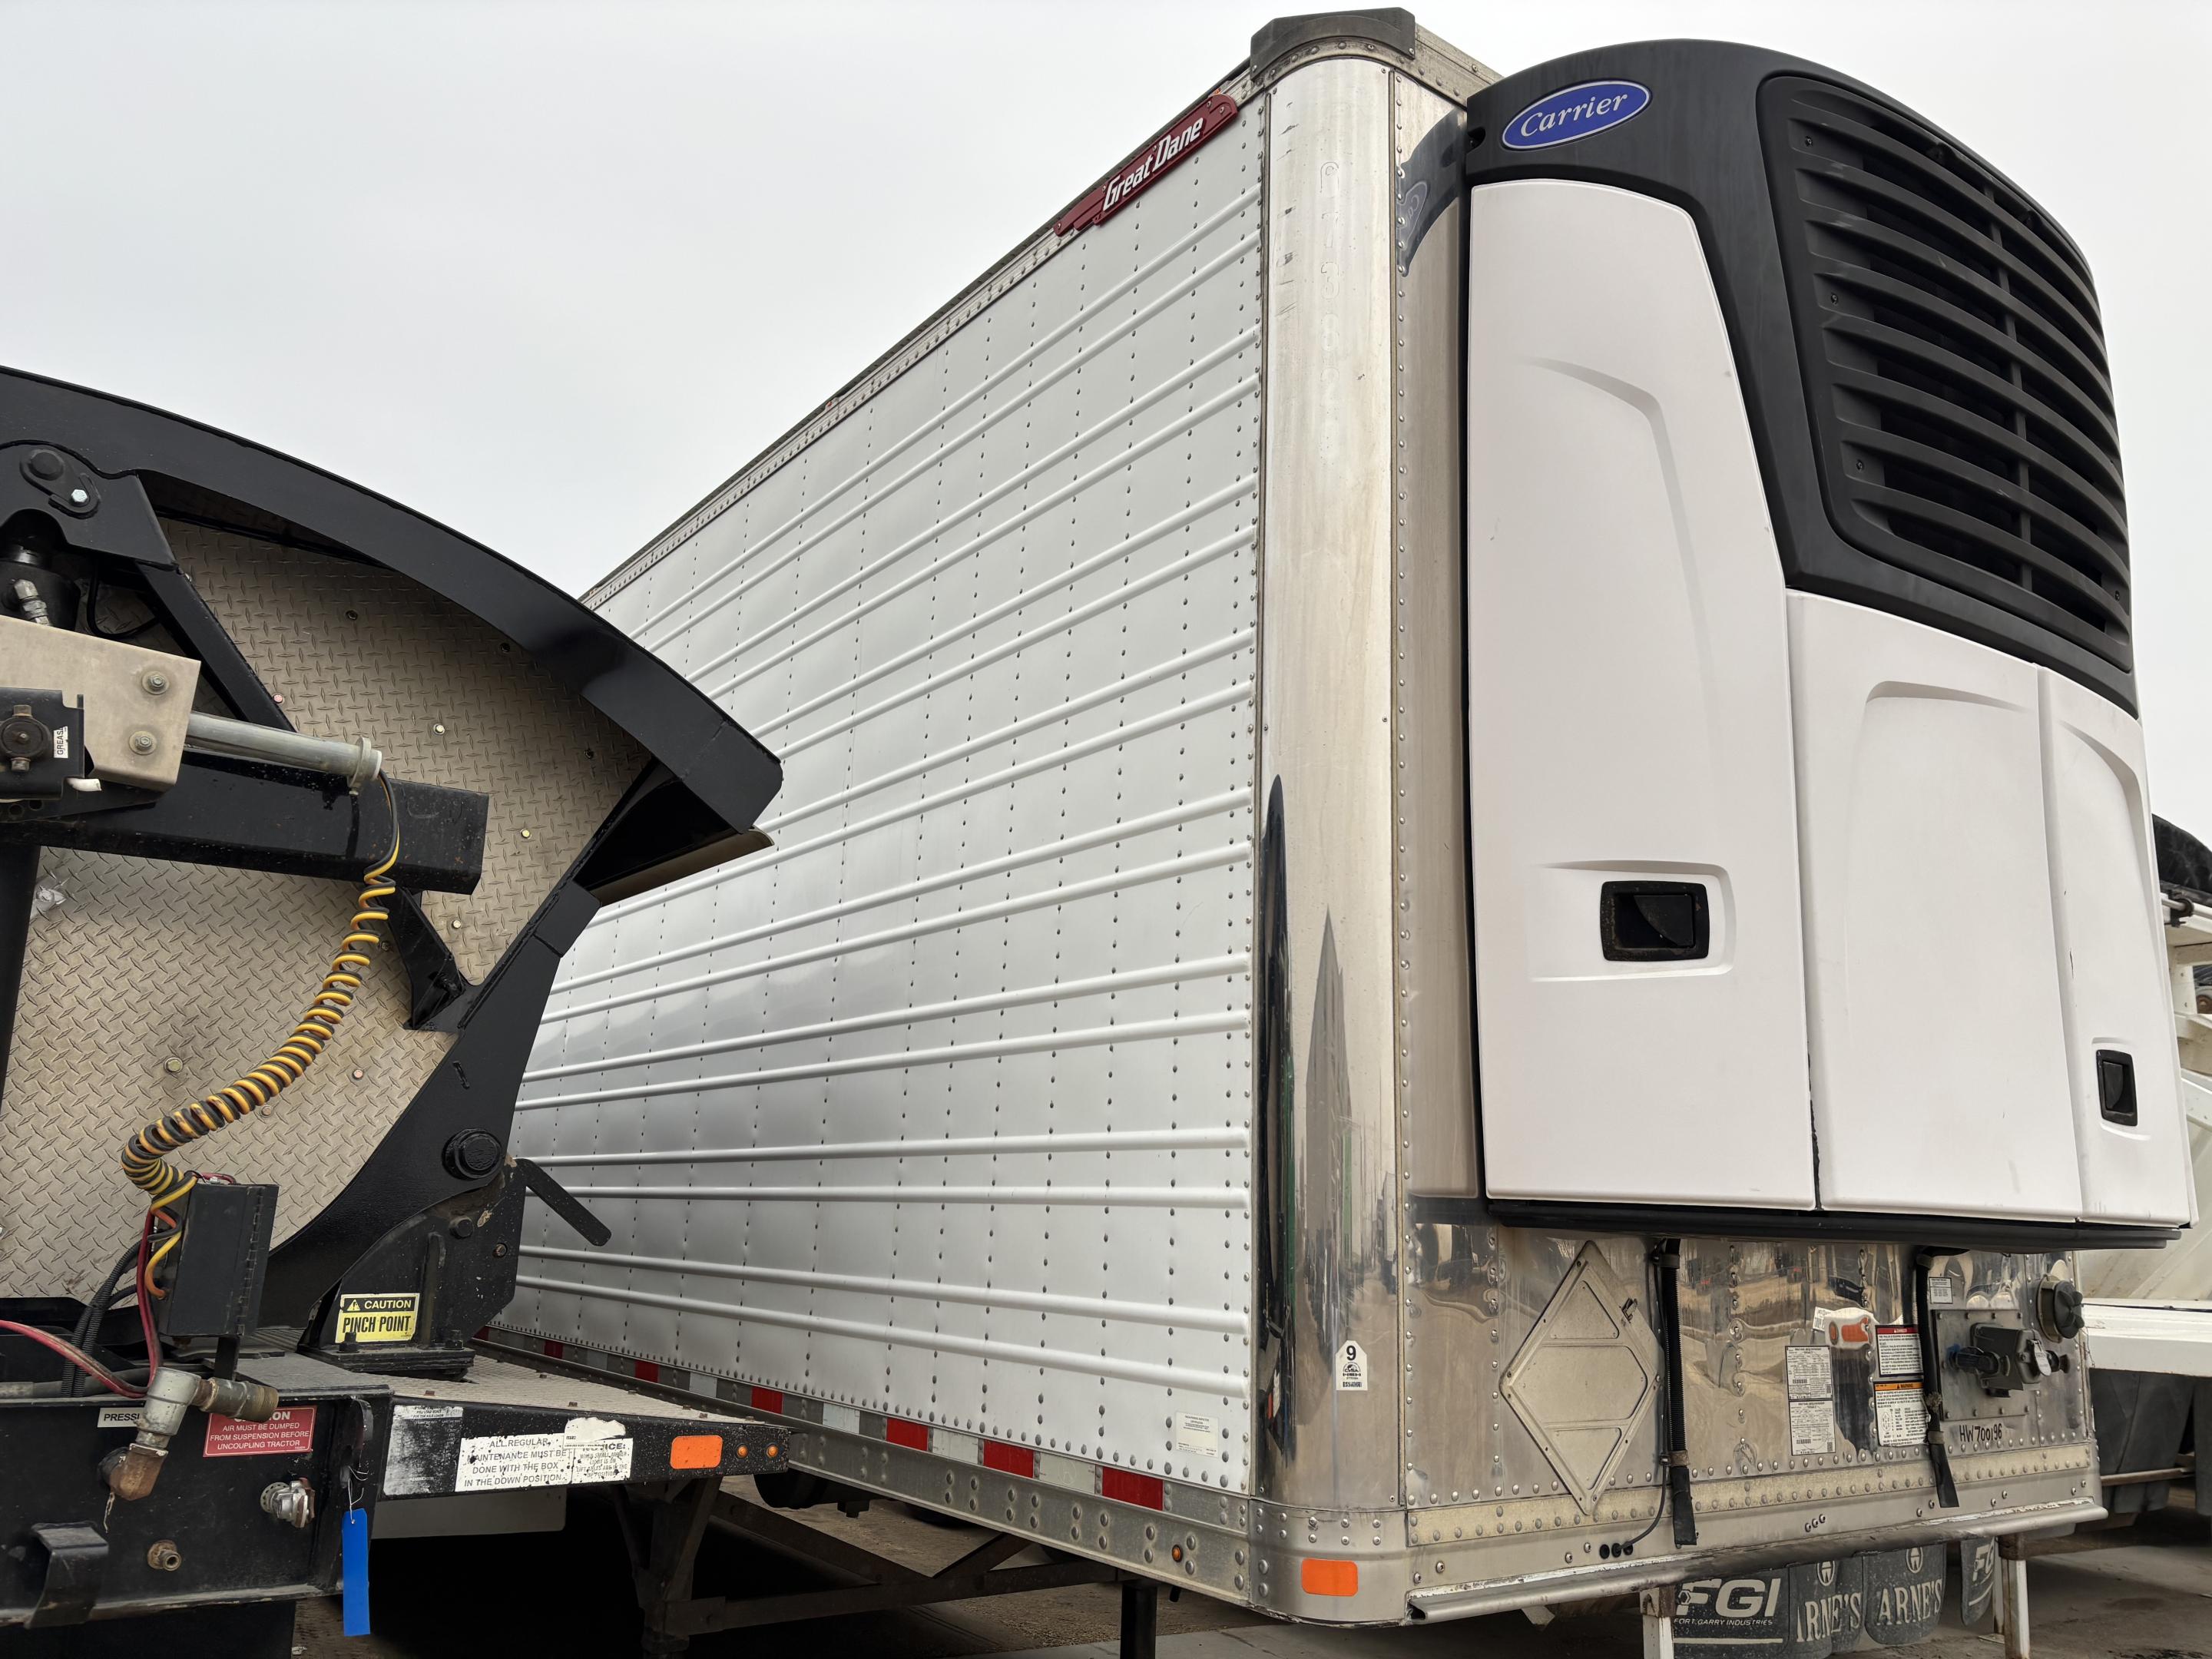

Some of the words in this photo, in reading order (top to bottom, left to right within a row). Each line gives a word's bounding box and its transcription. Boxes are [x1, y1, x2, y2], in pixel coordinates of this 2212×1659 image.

[1521, 94, 1628, 137] Carrier
[1103, 154, 1153, 211] Great
[1152, 118, 1204, 173] Dane
[364, 1300, 412, 1310] CAUTION
[343, 1316, 376, 1333] PINCH
[379, 1316, 411, 1332] POINT
[1346, 1345, 1356, 1361] 9
[217, 1442, 265, 1450] UNCOUPLING
[508, 1438, 548, 1447] REGULAR
[531, 1450, 554, 1459] MUST
[472, 1465, 497, 1474] DONE
[499, 1464, 521, 1472] WITH
[541, 1462, 558, 1470] BOX
[495, 1476, 521, 1485] DOWN
[1676, 1578, 1781, 1618] FGI
[1876, 1578, 1942, 1626] ARNE'S
